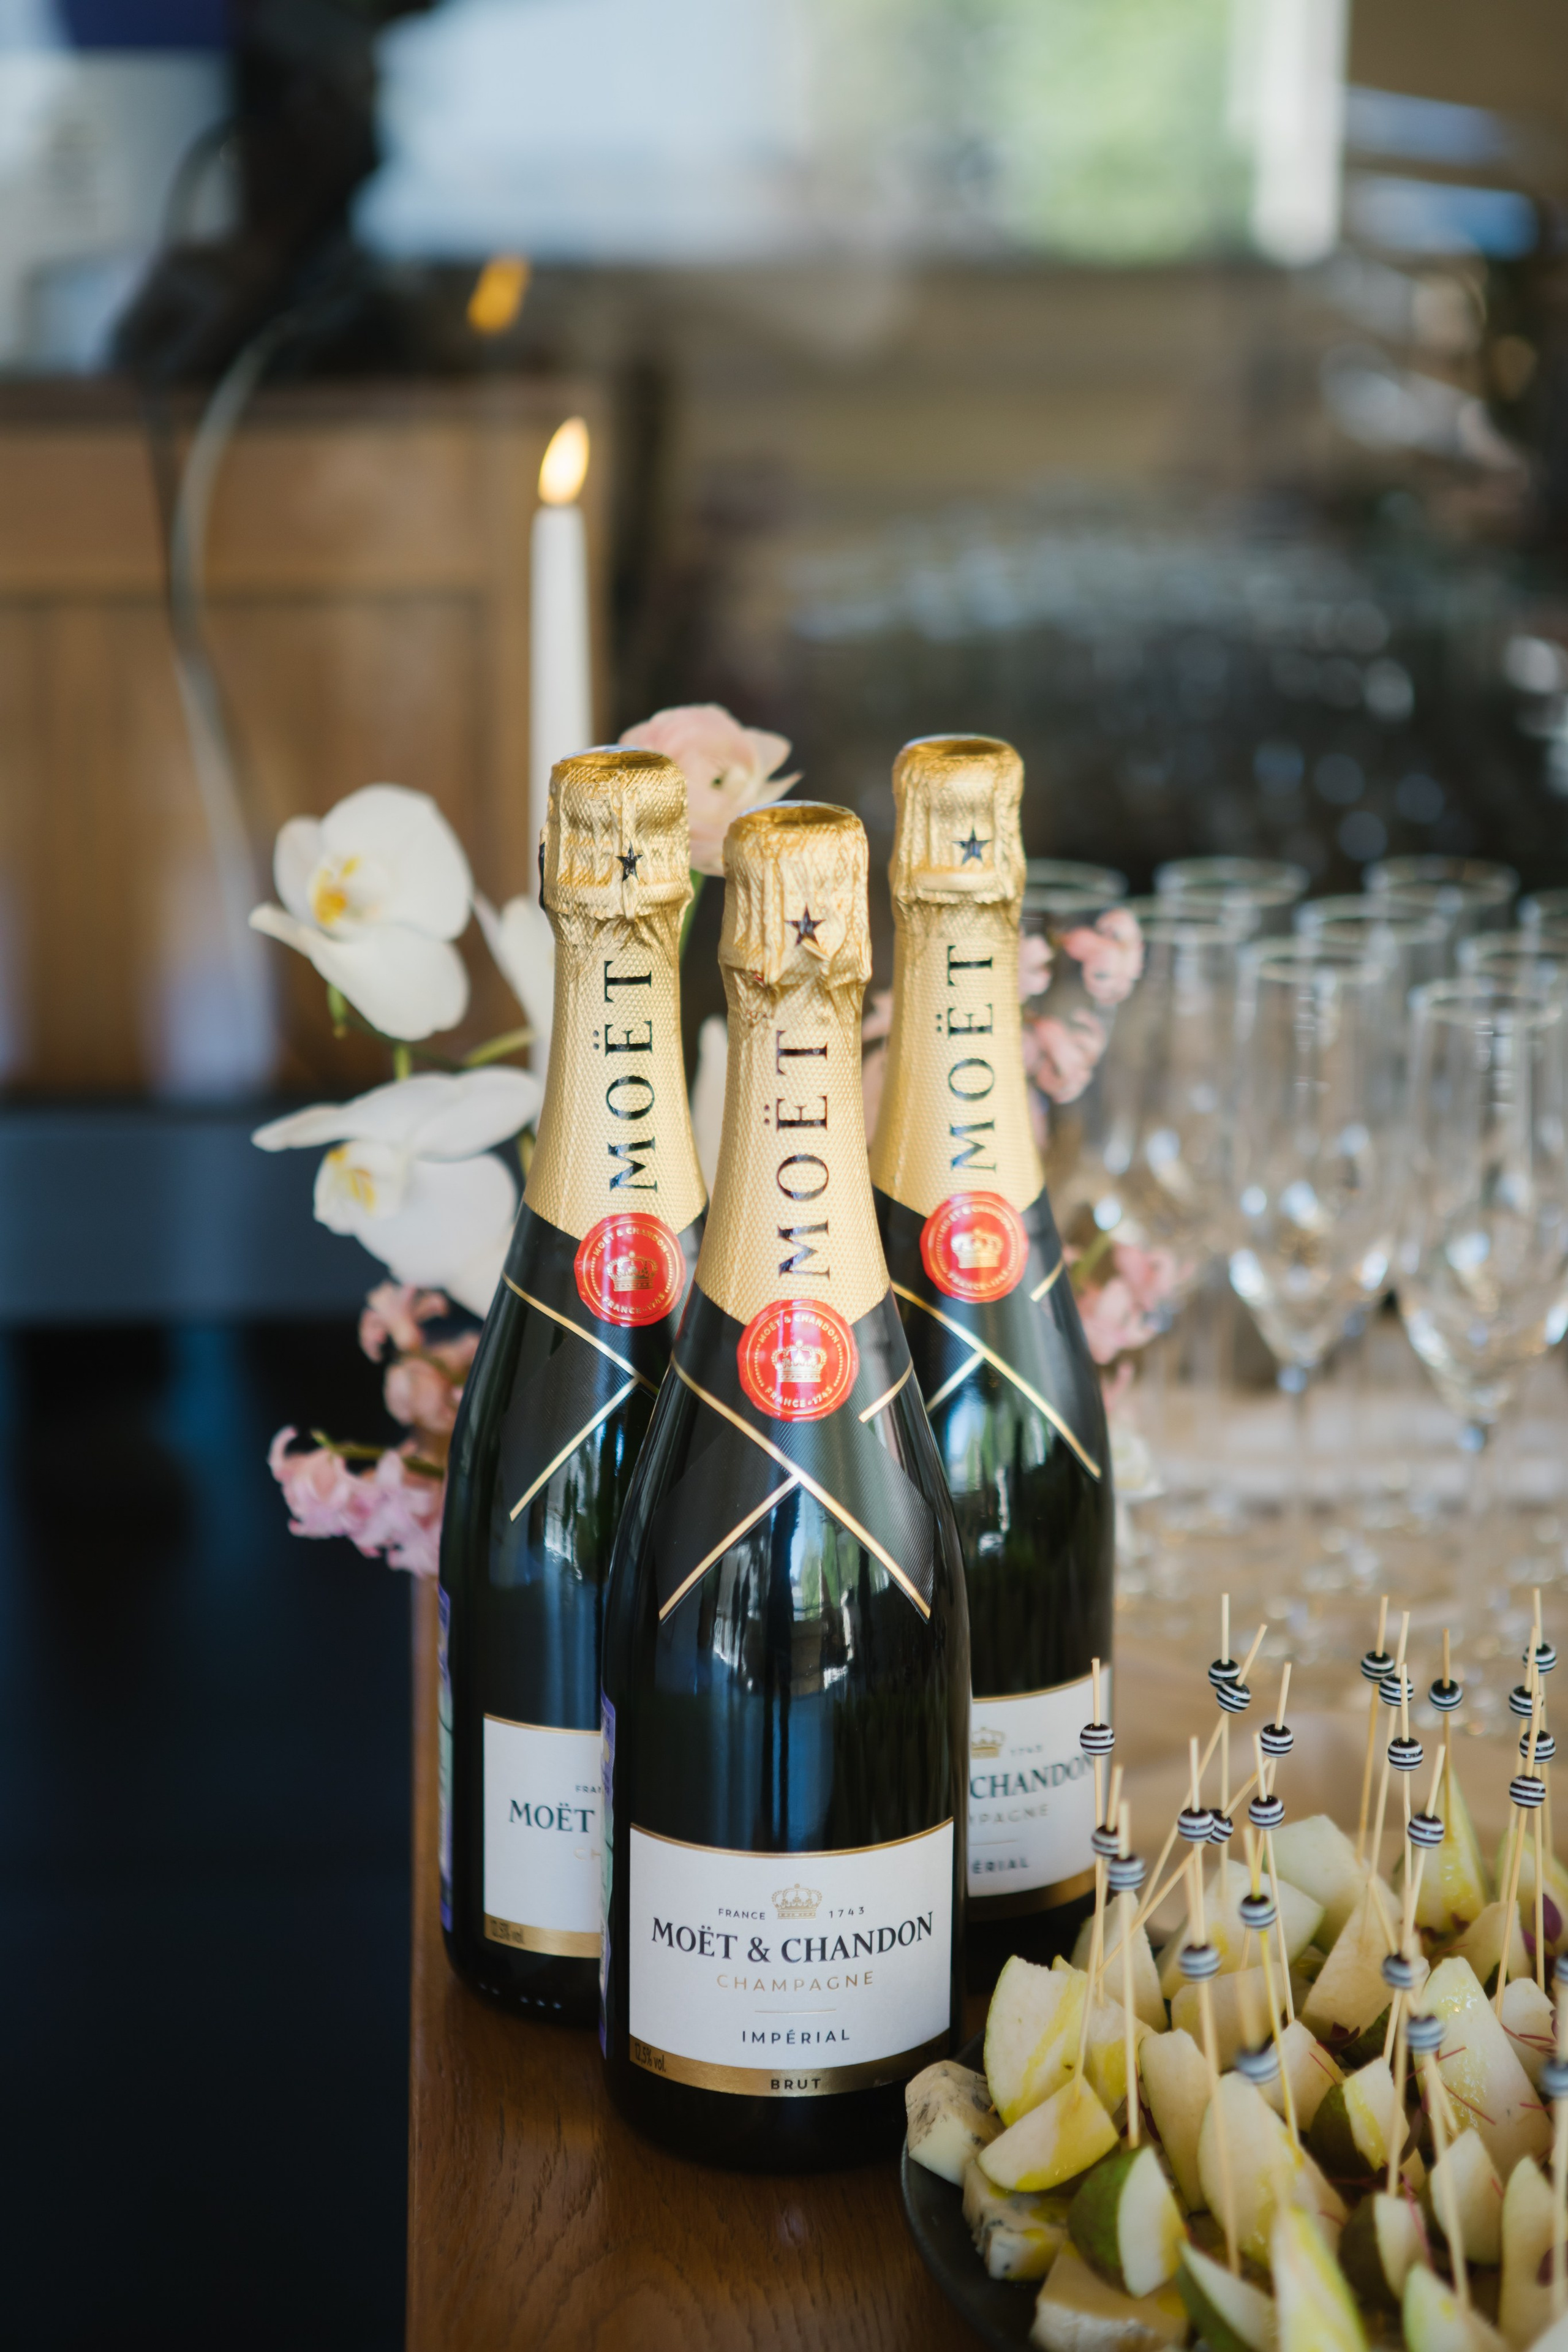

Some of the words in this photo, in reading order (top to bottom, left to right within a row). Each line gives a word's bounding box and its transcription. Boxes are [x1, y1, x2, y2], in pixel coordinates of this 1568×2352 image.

[937, 944, 997, 1172] MOËT
[592, 960, 658, 1193] MOËT
[764, 1030, 831, 1280] MOËT
[794, 1315, 840, 1343] CHANDON
[765, 1387, 806, 1408] FRANCE
[509, 1798, 595, 1833] MOËT
[718, 1908, 766, 1920] FRANCE
[829, 1906, 865, 1918] 1743
[651, 1917, 737, 1960] MOËT
[747, 1937, 771, 1962] &
[781, 1912, 933, 1963] CHANDON
[716, 1970, 874, 1992] CHAMPAGNE
[742, 2029, 850, 2045] IMPÉRIAL
[771, 2078, 821, 2090] BRUT
